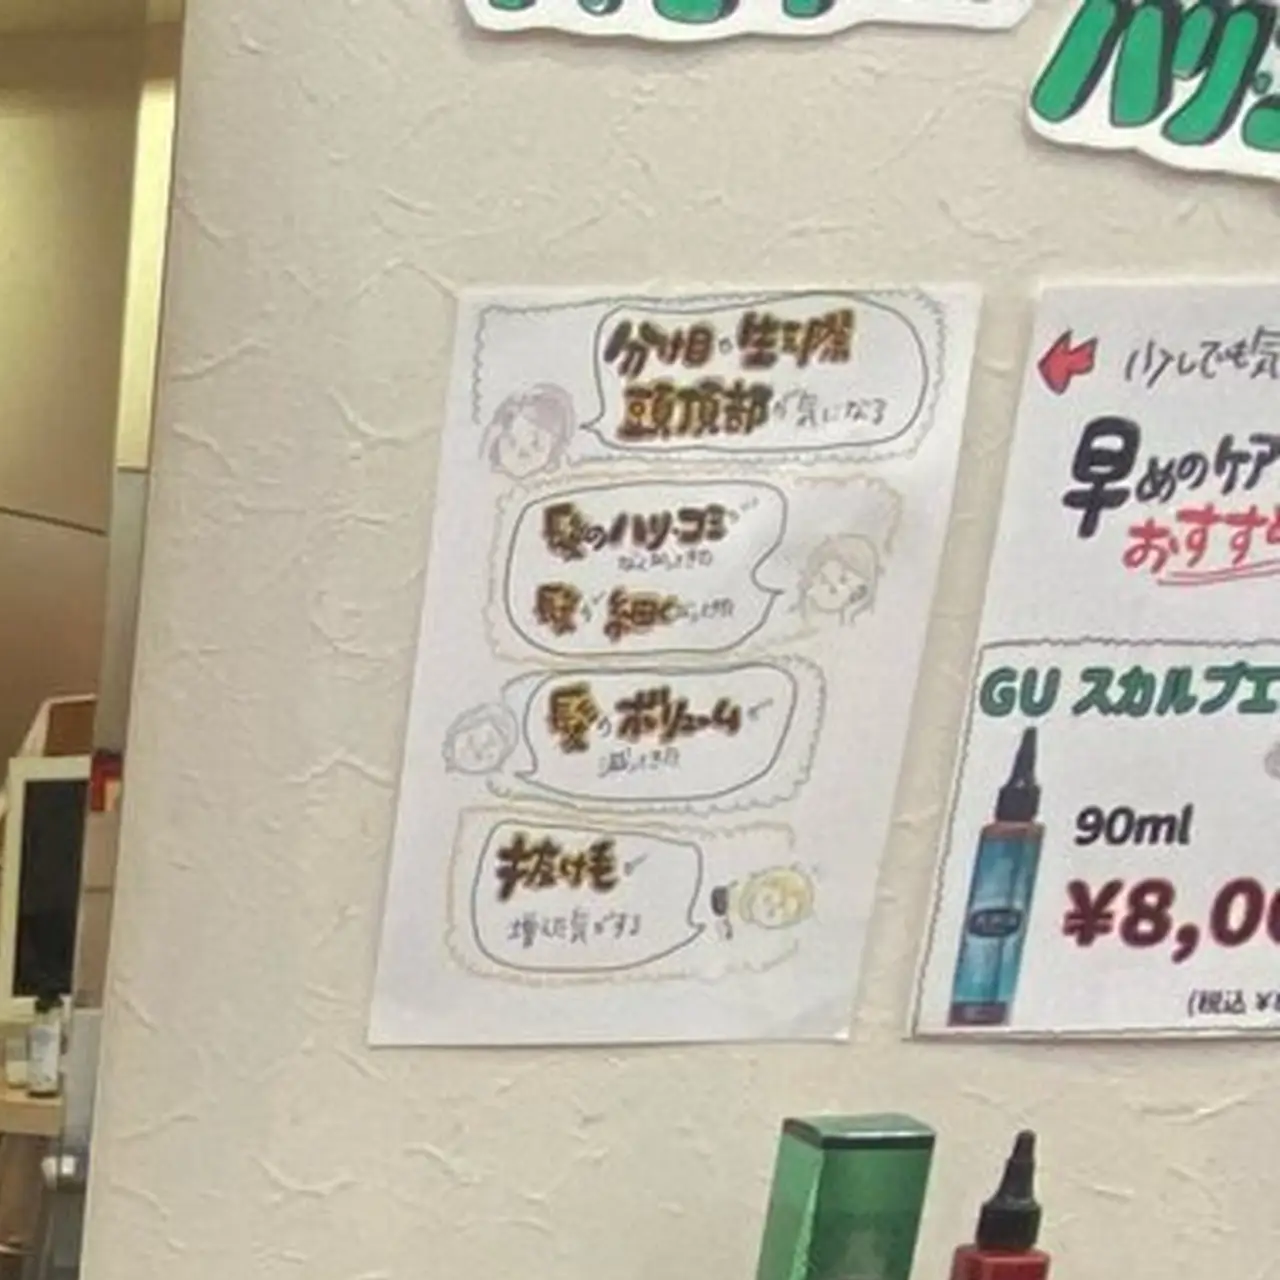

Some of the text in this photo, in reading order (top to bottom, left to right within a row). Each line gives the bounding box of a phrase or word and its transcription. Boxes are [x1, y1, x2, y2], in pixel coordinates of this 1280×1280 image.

[1061, 415, 1280, 539] 早めのケア
[978, 666, 1062, 718] GU
[1074, 804, 1195, 847] 90ml
[1062, 877, 1280, 964] ¥8,0
